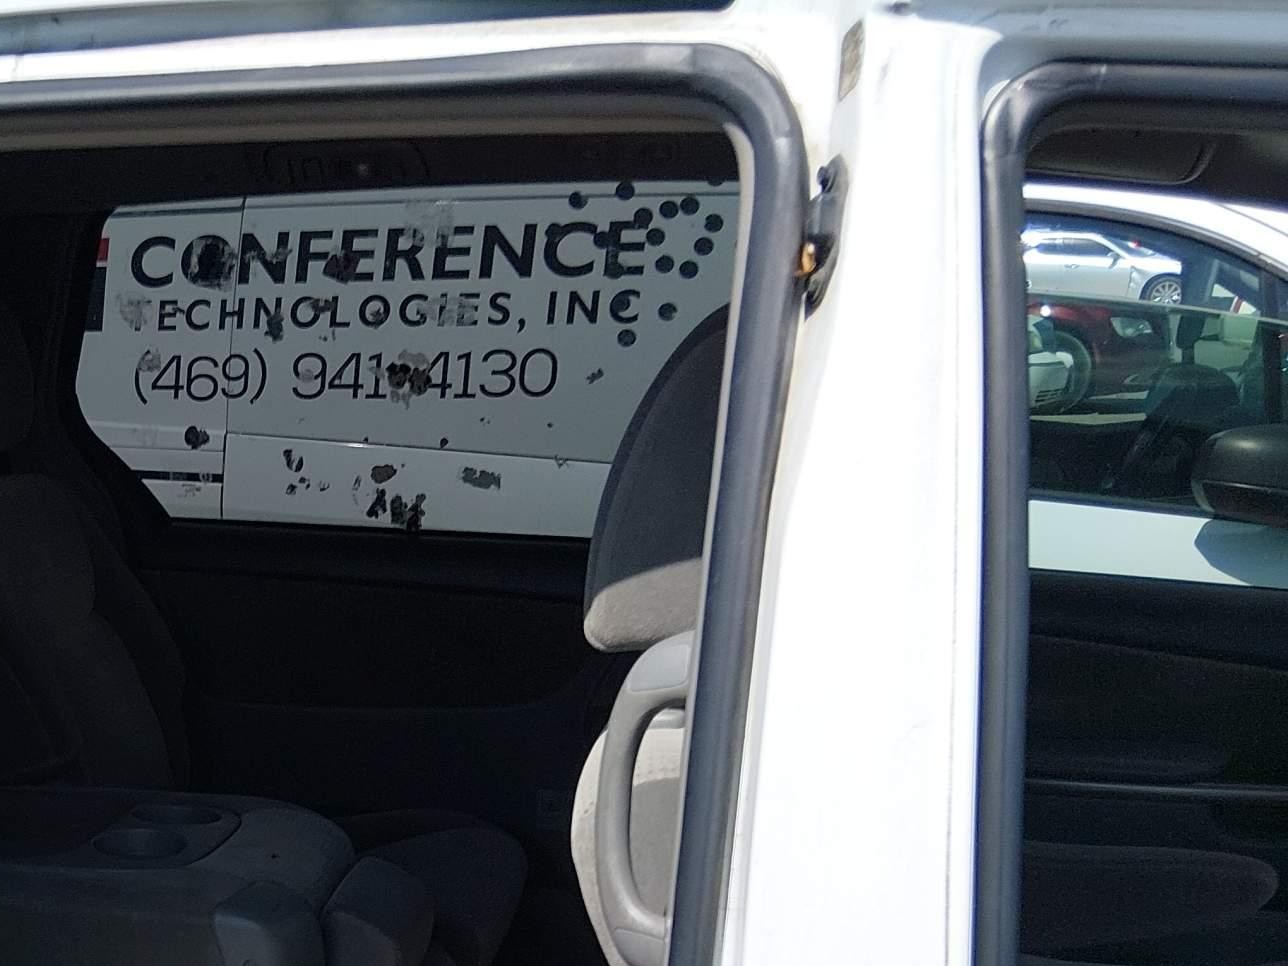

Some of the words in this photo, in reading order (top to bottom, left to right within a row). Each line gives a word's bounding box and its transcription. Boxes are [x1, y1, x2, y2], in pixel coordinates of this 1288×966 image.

[130, 220, 649, 289] CONFERENCE
[134, 348, 267, 405] (469)
[291, 348, 558, 400] 9414130
